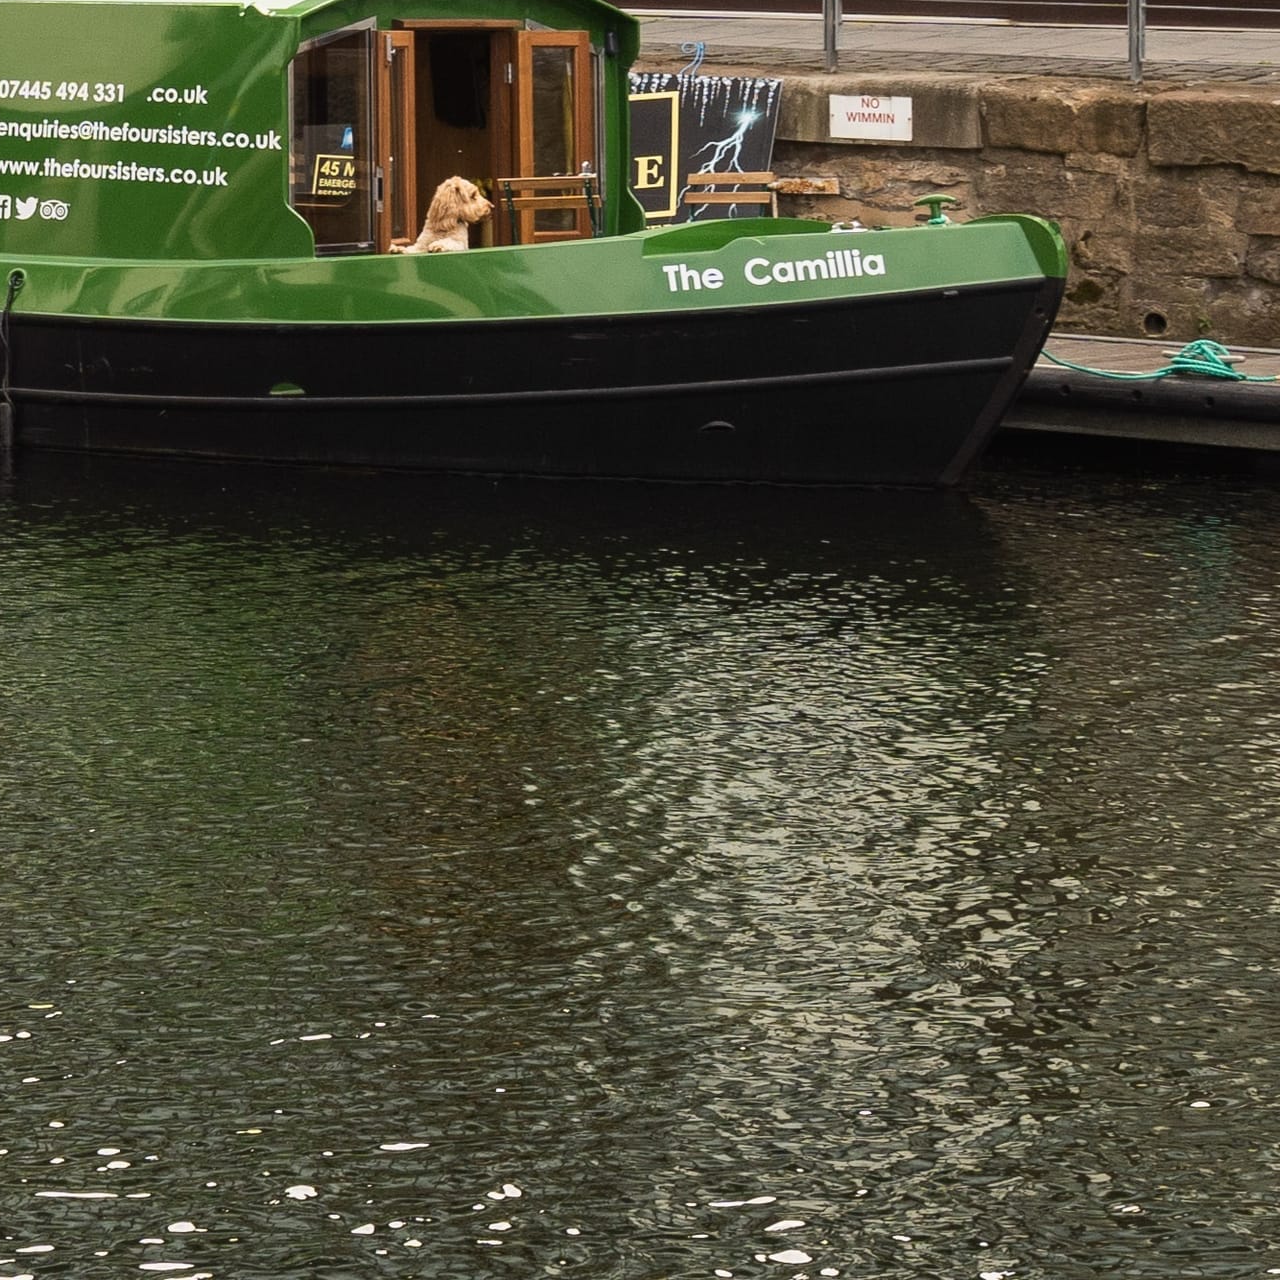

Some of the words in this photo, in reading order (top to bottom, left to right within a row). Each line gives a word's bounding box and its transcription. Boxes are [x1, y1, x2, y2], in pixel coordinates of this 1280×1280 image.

[56, 81, 89, 101] 494
[93, 83, 125, 103] 331
[146, 85, 209, 105] .co.uk
[860, 97, 880, 109] NO
[320, 160, 341, 176] 45
[633, 155, 665, 189] E
[662, 263, 725, 292] The
[743, 249, 887, 286] Camillia
